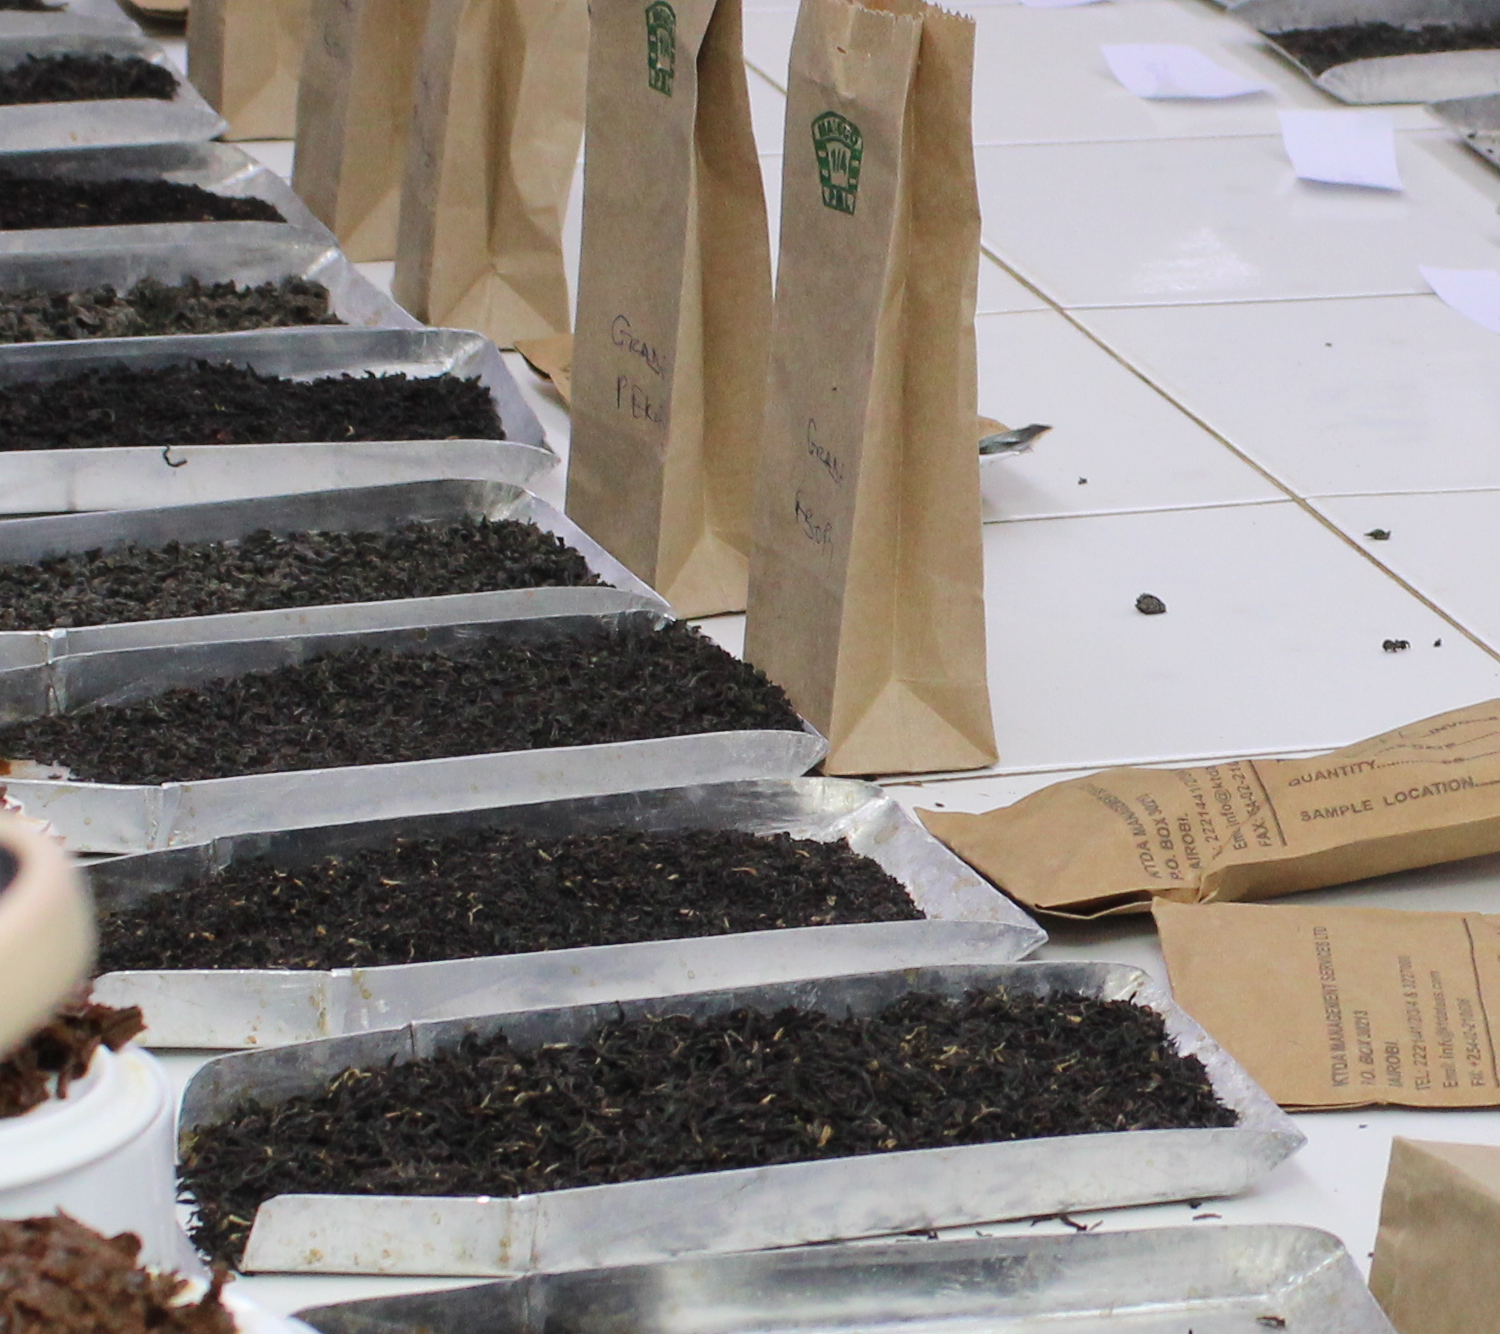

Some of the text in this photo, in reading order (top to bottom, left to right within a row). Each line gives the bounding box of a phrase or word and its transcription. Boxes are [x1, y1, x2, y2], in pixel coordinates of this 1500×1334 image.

[1287, 758, 1378, 788] QUANTITY
[1300, 775, 1476, 823] SAMPLE LOCATION
[1153, 816, 1175, 853] BOX
[1176, 812, 1202, 870] AIROBI.
[1330, 1052, 1350, 1087] KTDA
